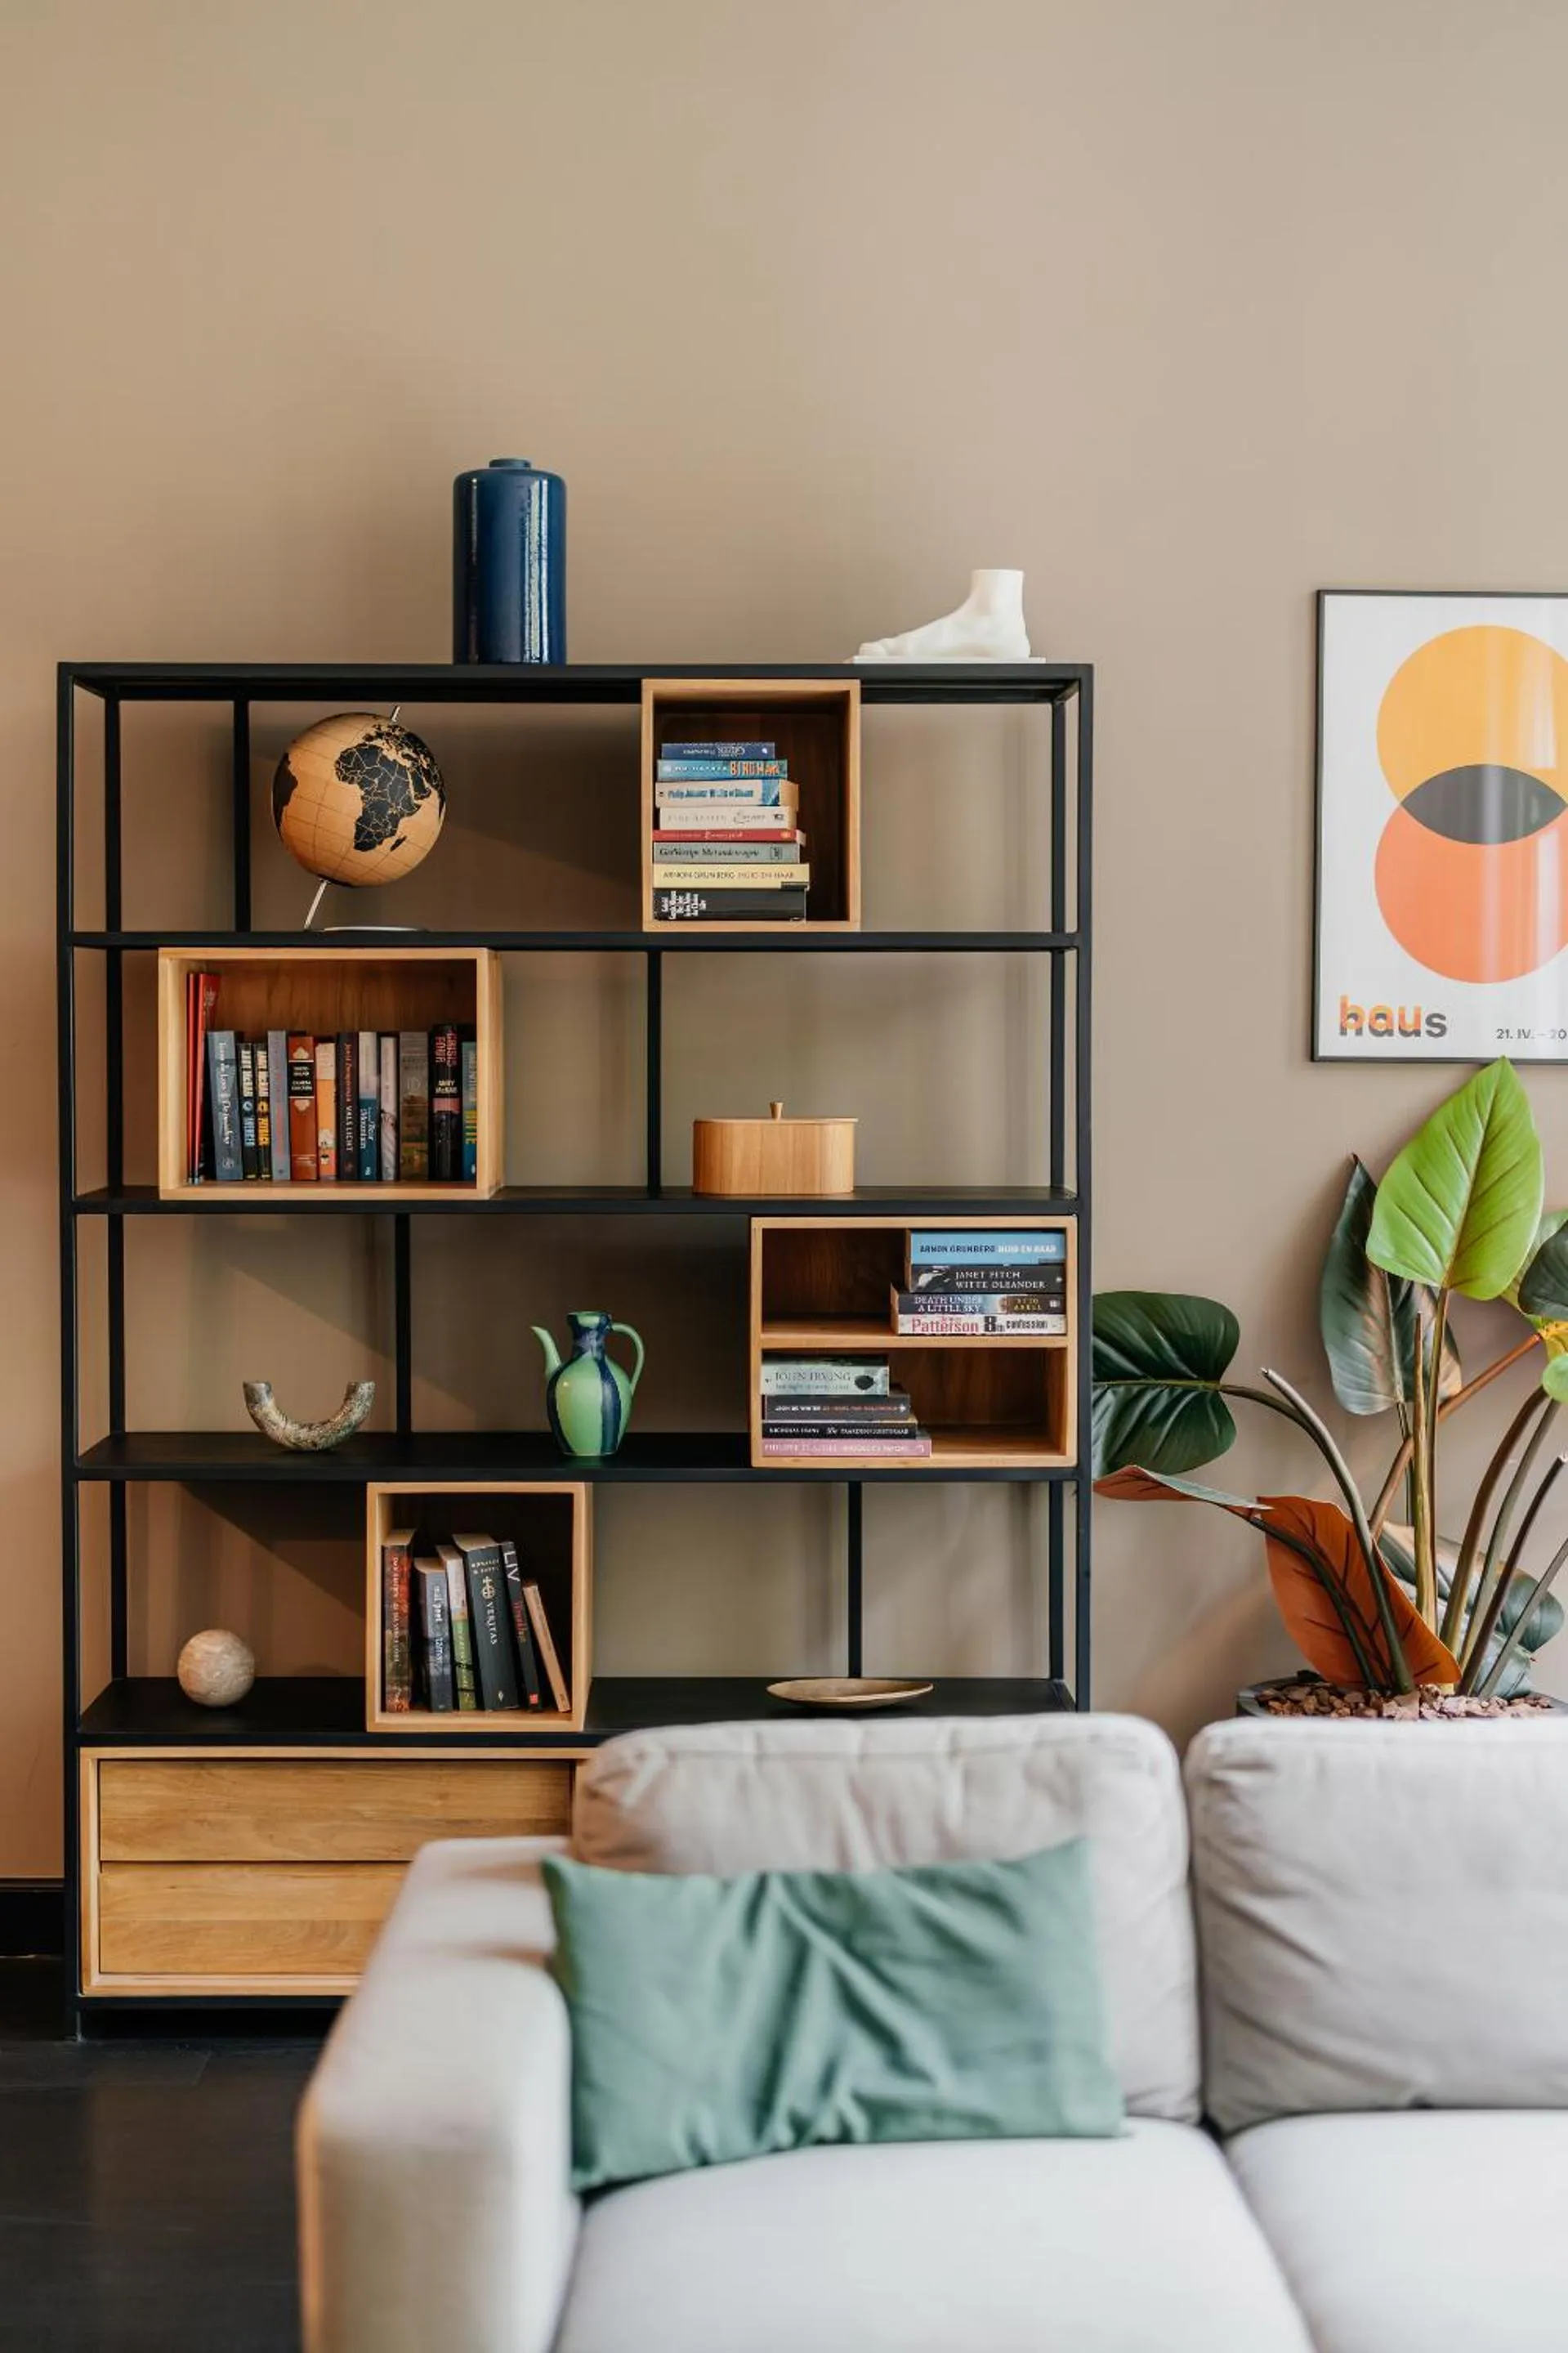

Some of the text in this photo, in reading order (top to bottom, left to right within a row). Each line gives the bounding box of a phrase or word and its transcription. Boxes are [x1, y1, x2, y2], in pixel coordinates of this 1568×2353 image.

[1494, 1028, 1513, 1040] 21.
[955, 1271, 985, 1280] JANET
[955, 1281, 1047, 1289] WITTE OLEANDER
[914, 1295, 948, 1304] DEATH
[911, 1317, 979, 1332] Patterson
[775, 1371, 851, 1381] JOHN IRVING
[503, 1551, 520, 1583] LIV
[486, 1601, 498, 1645] VERITAS
